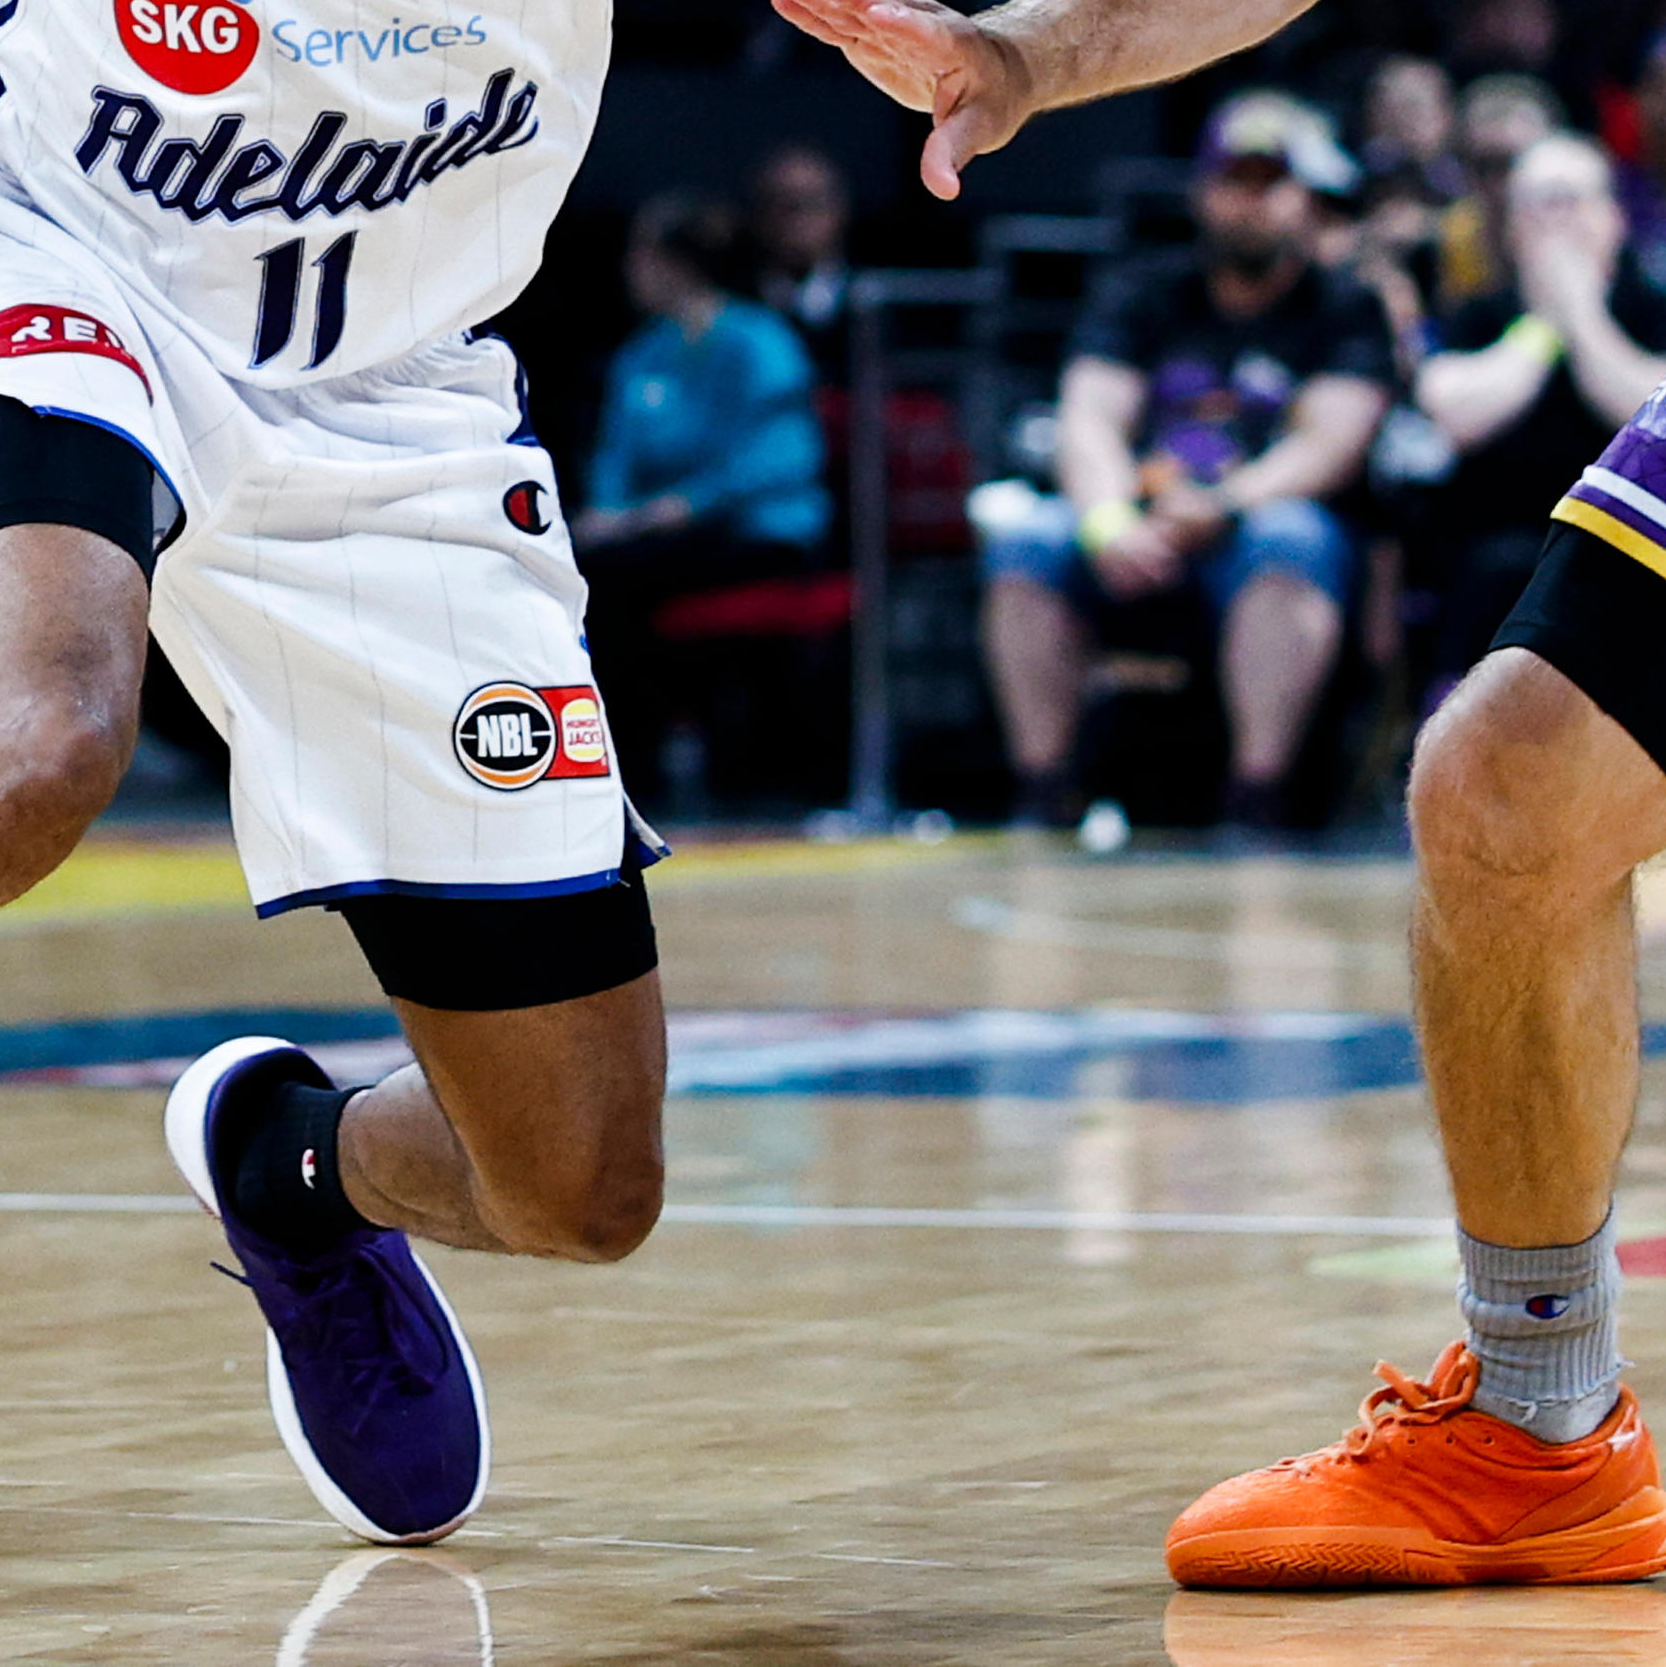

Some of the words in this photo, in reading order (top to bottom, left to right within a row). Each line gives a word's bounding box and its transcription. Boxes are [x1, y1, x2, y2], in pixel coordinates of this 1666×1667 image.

[272, 15, 487, 68] Services
[74, 67, 539, 226] Adelaide
[247, 230, 359, 372] 11
[476, 712, 539, 758] NBL
